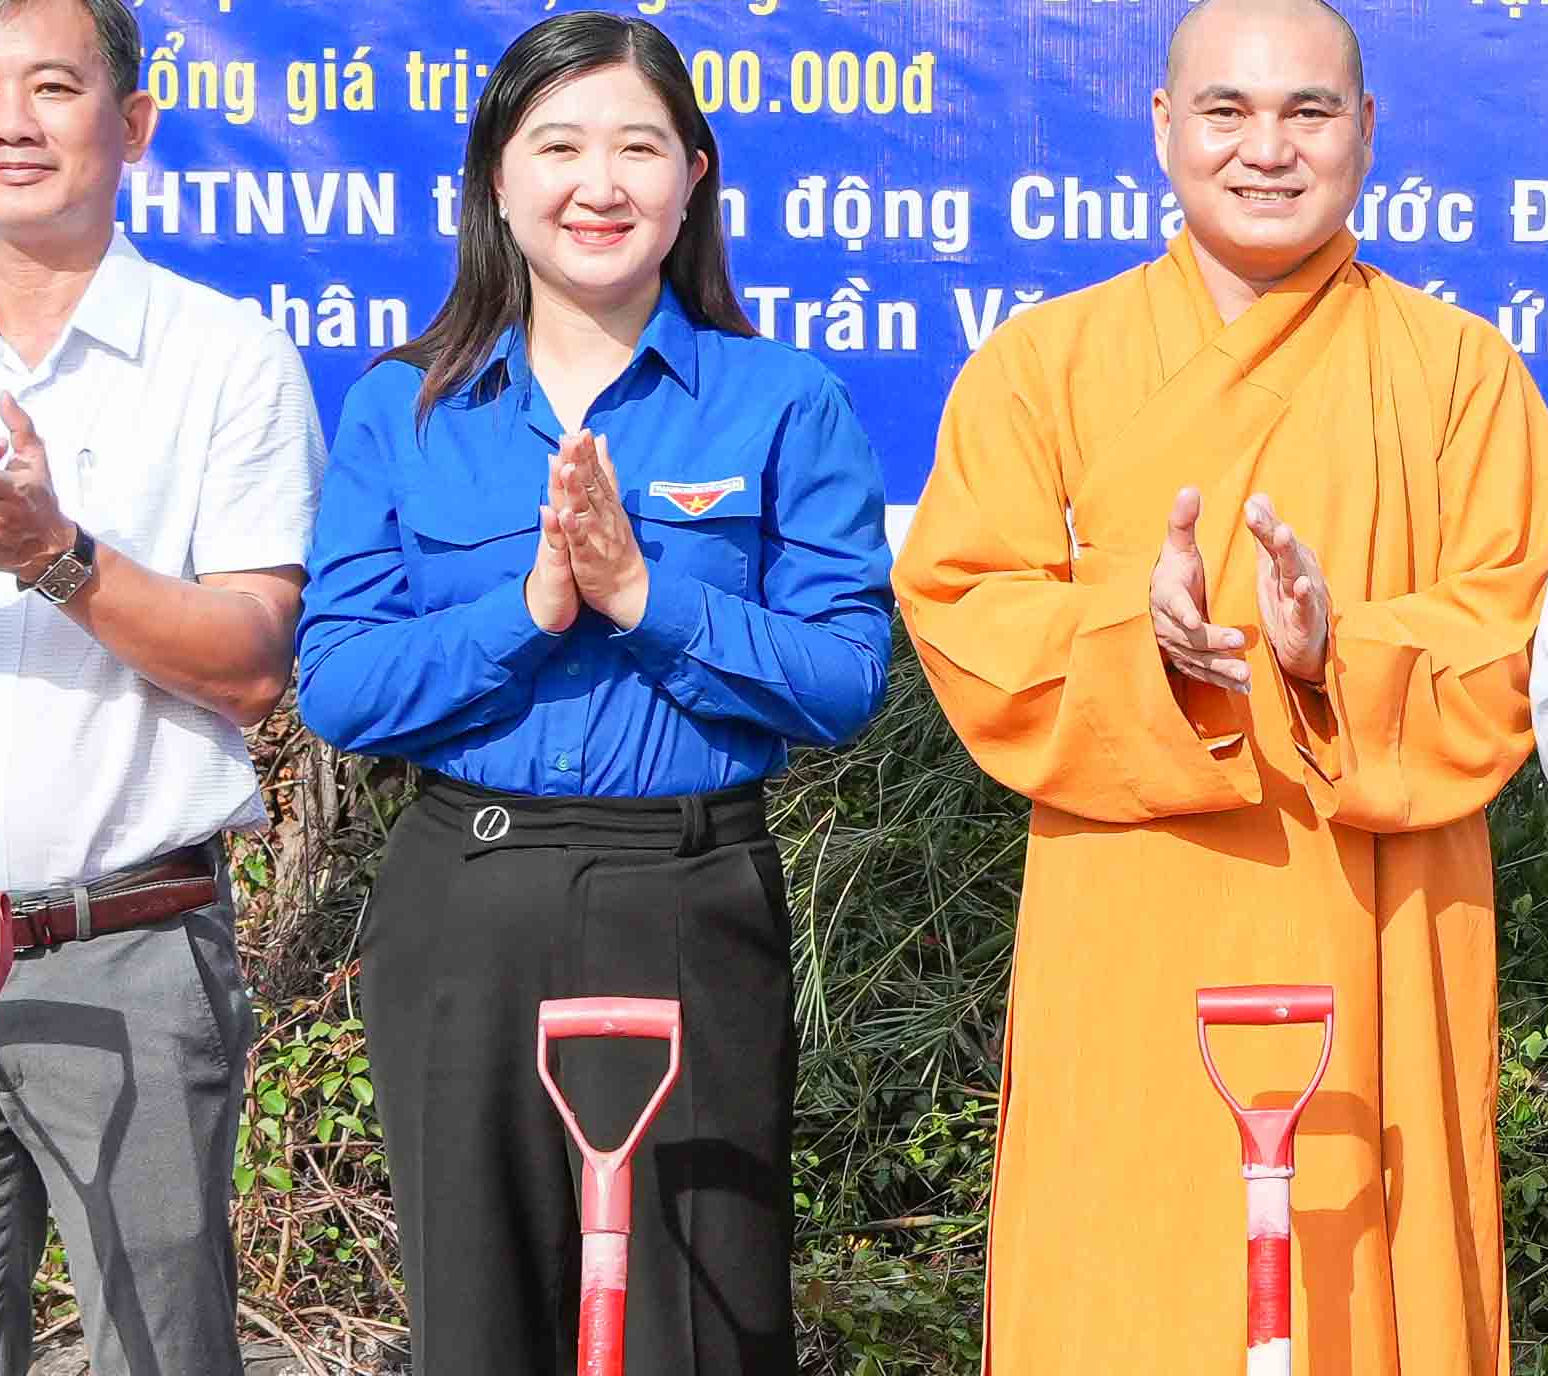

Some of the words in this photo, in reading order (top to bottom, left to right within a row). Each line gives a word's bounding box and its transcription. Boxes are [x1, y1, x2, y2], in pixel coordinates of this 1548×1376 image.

[142, 30, 256, 125] ổng
[288, 48, 375, 126] giá
[113, 170, 396, 236] HTNVN
[785, 176, 972, 254] động
[1350, 176, 1473, 243] ước
[743, 277, 917, 351] Trần
